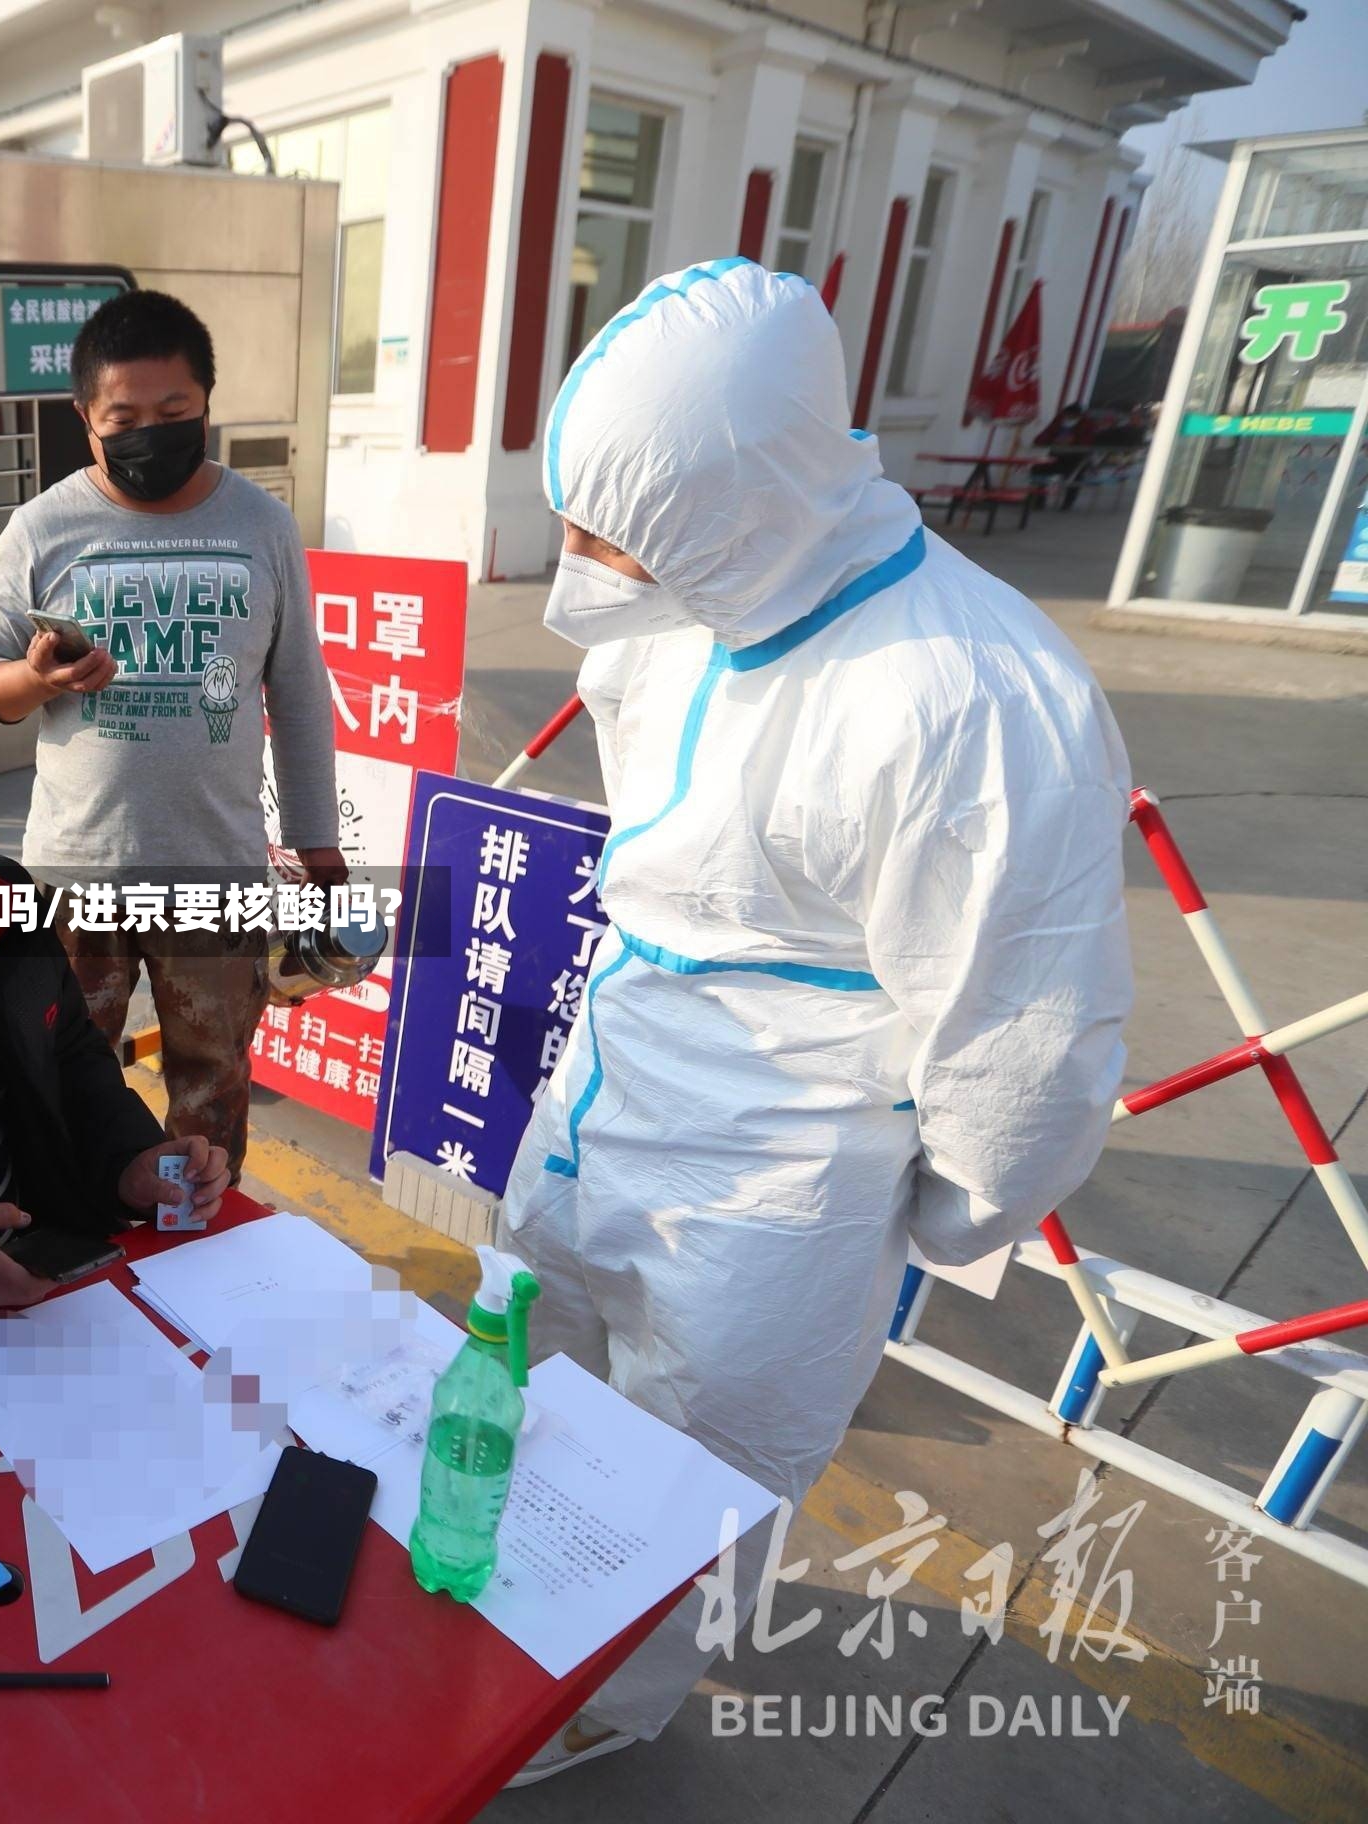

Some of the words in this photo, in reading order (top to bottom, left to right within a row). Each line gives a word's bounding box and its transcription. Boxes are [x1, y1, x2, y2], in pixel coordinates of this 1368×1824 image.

[1239, 281, 1349, 363] 开
[107, 541, 130, 550] KING
[132, 540, 157, 549] WILL
[158, 539, 190, 549] NEVER
[193, 538, 205, 547] BE
[207, 538, 238, 548] TAMED
[71, 561, 251, 621] NEVER
[100, 691, 111, 701] NO
[114, 691, 130, 702] ONE
[134, 692, 151, 703] CAN
[154, 692, 189, 704] SNATCH
[100, 702, 123, 716] THEM
[125, 704, 149, 717] AWAY
[152, 705, 177, 718] FROM
[179, 706, 192, 718] ME
[98, 729, 151, 742] BASKETBALL
[436, 824, 529, 1184] 排队请间隔一米
[300, 1011, 384, 1066] 扫一扫
